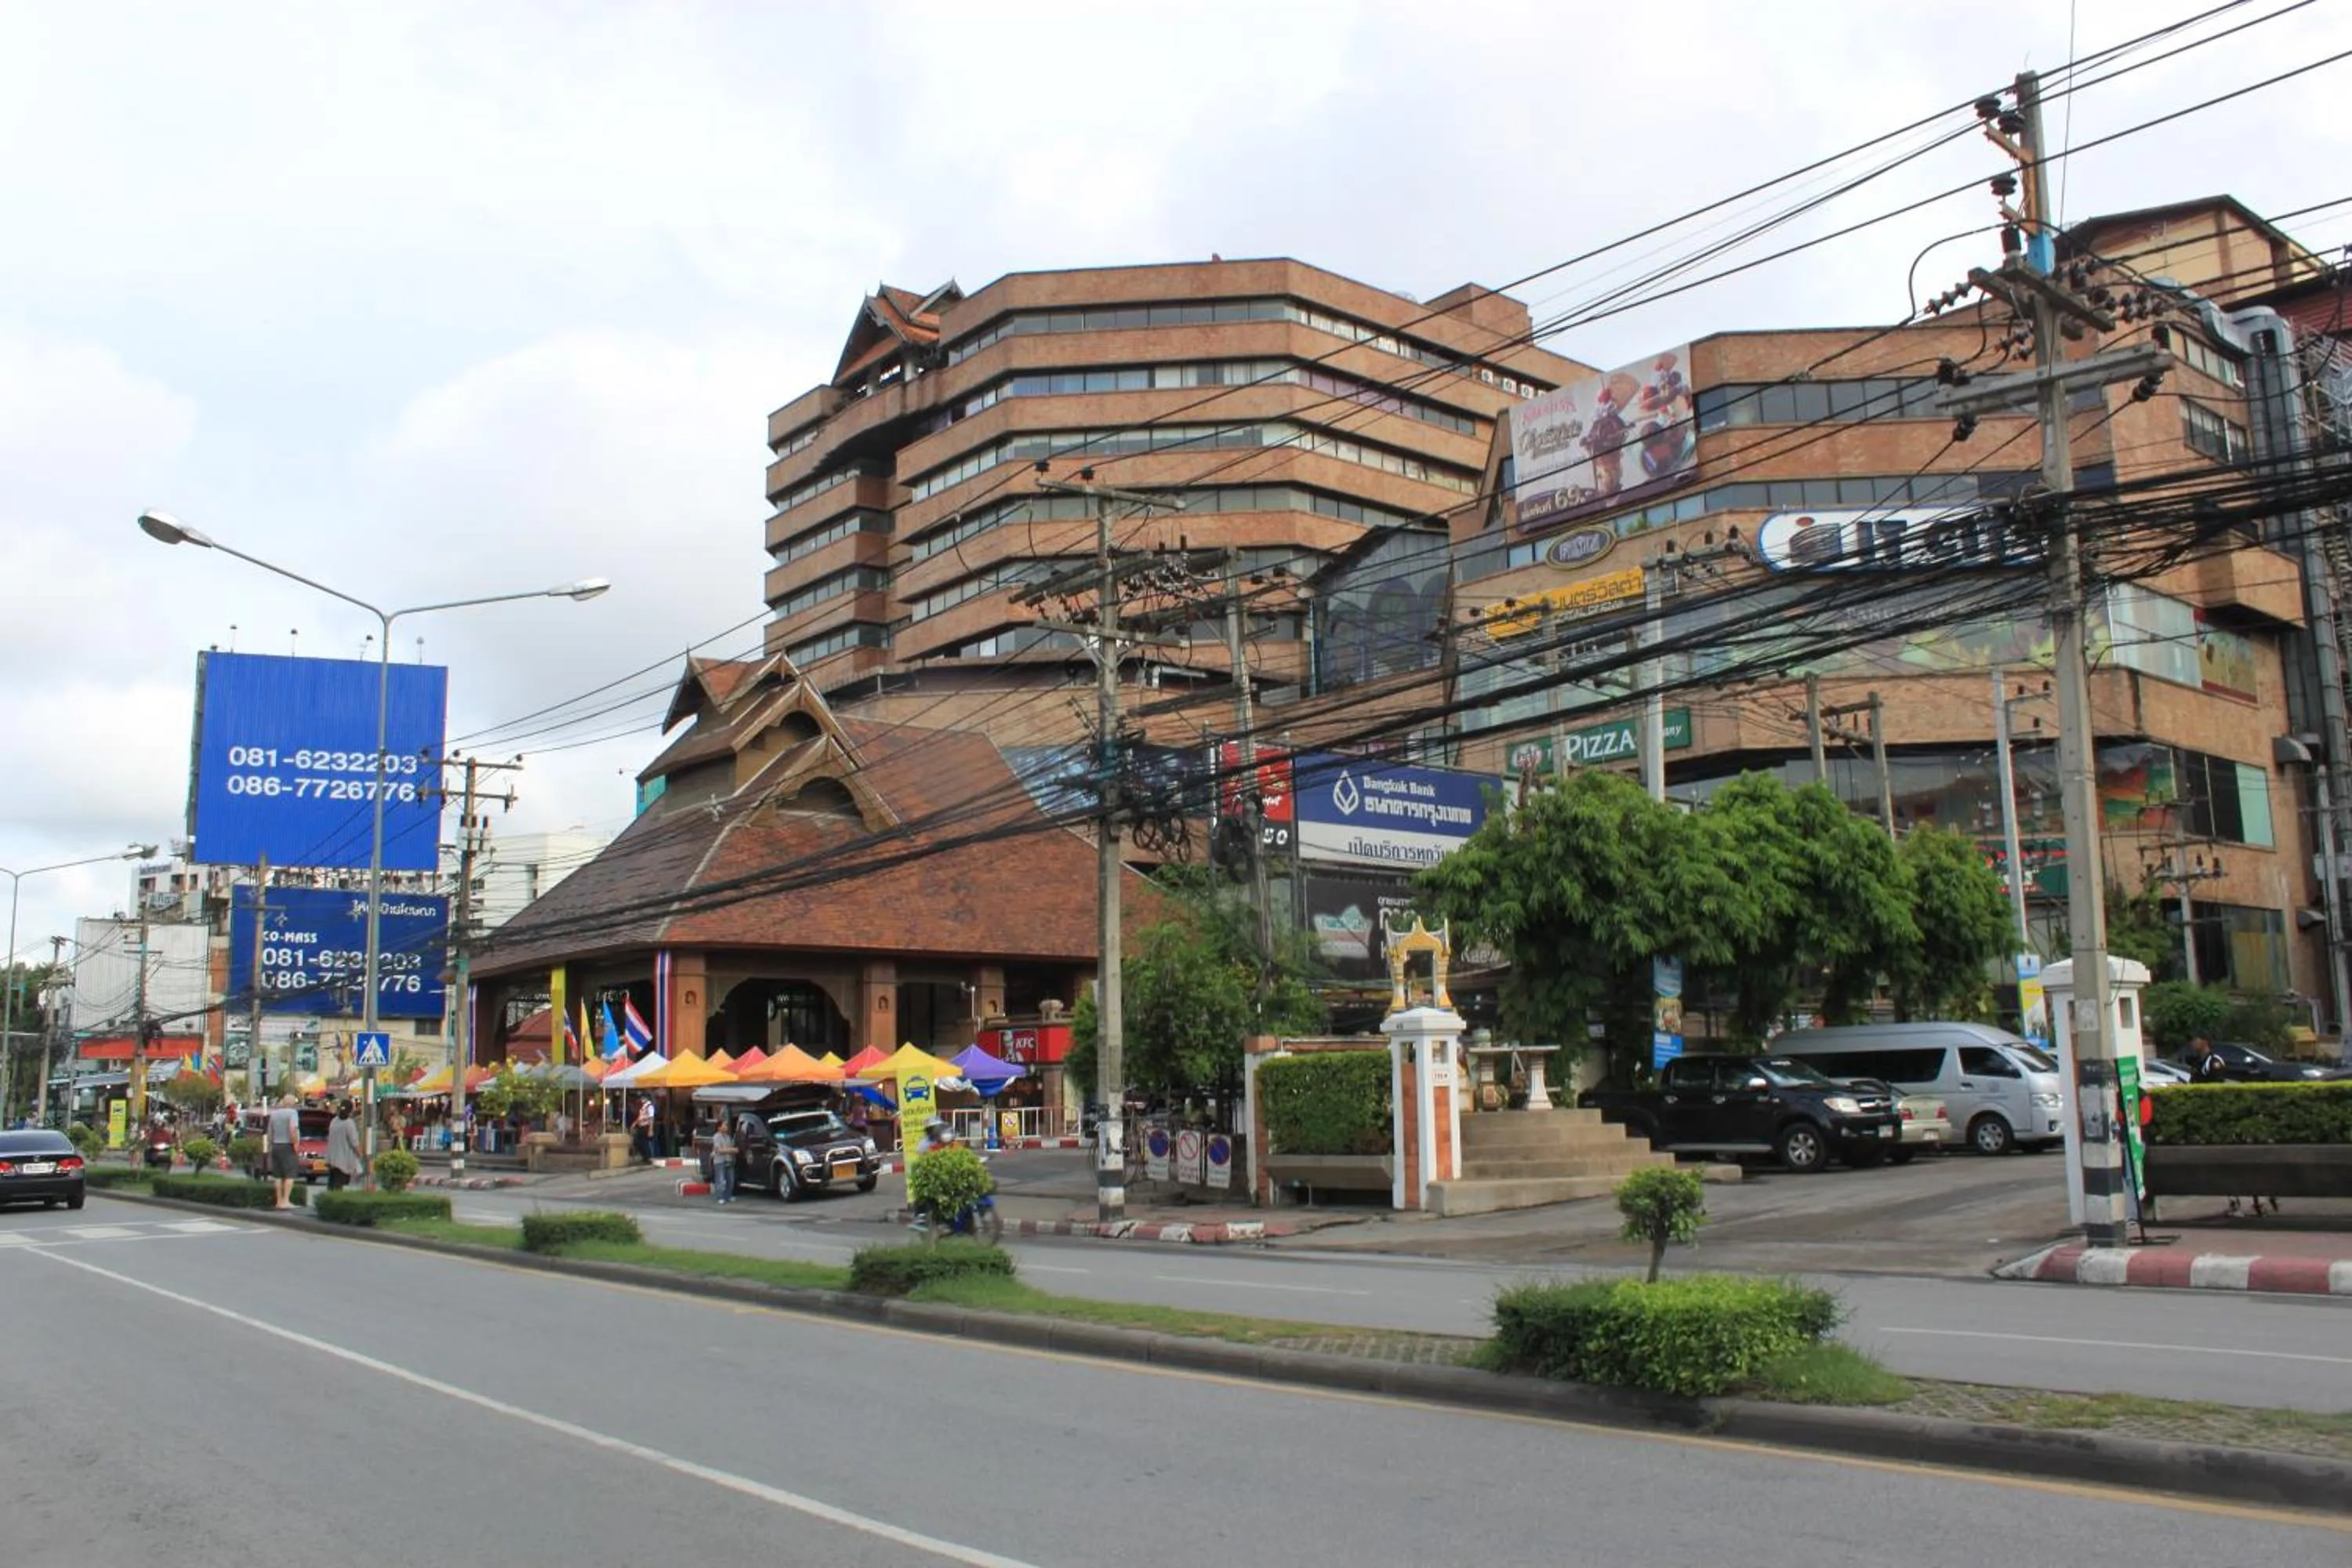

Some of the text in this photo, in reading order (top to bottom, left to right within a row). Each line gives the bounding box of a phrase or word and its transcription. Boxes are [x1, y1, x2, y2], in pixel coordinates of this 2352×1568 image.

[1565, 729, 1635, 760] PIZZA
[228, 746, 417, 775] 081-6232203
[227, 775, 416, 802] 086-7726776
[1363, 775, 1436, 797] Bangkok Bank
[1364, 796, 1472, 828] ธนาคารกรุงเทพ
[263, 948, 422, 971] 081-623203
[261, 971, 421, 993] 086-77776
[1015, 1036, 1035, 1049] KFC
